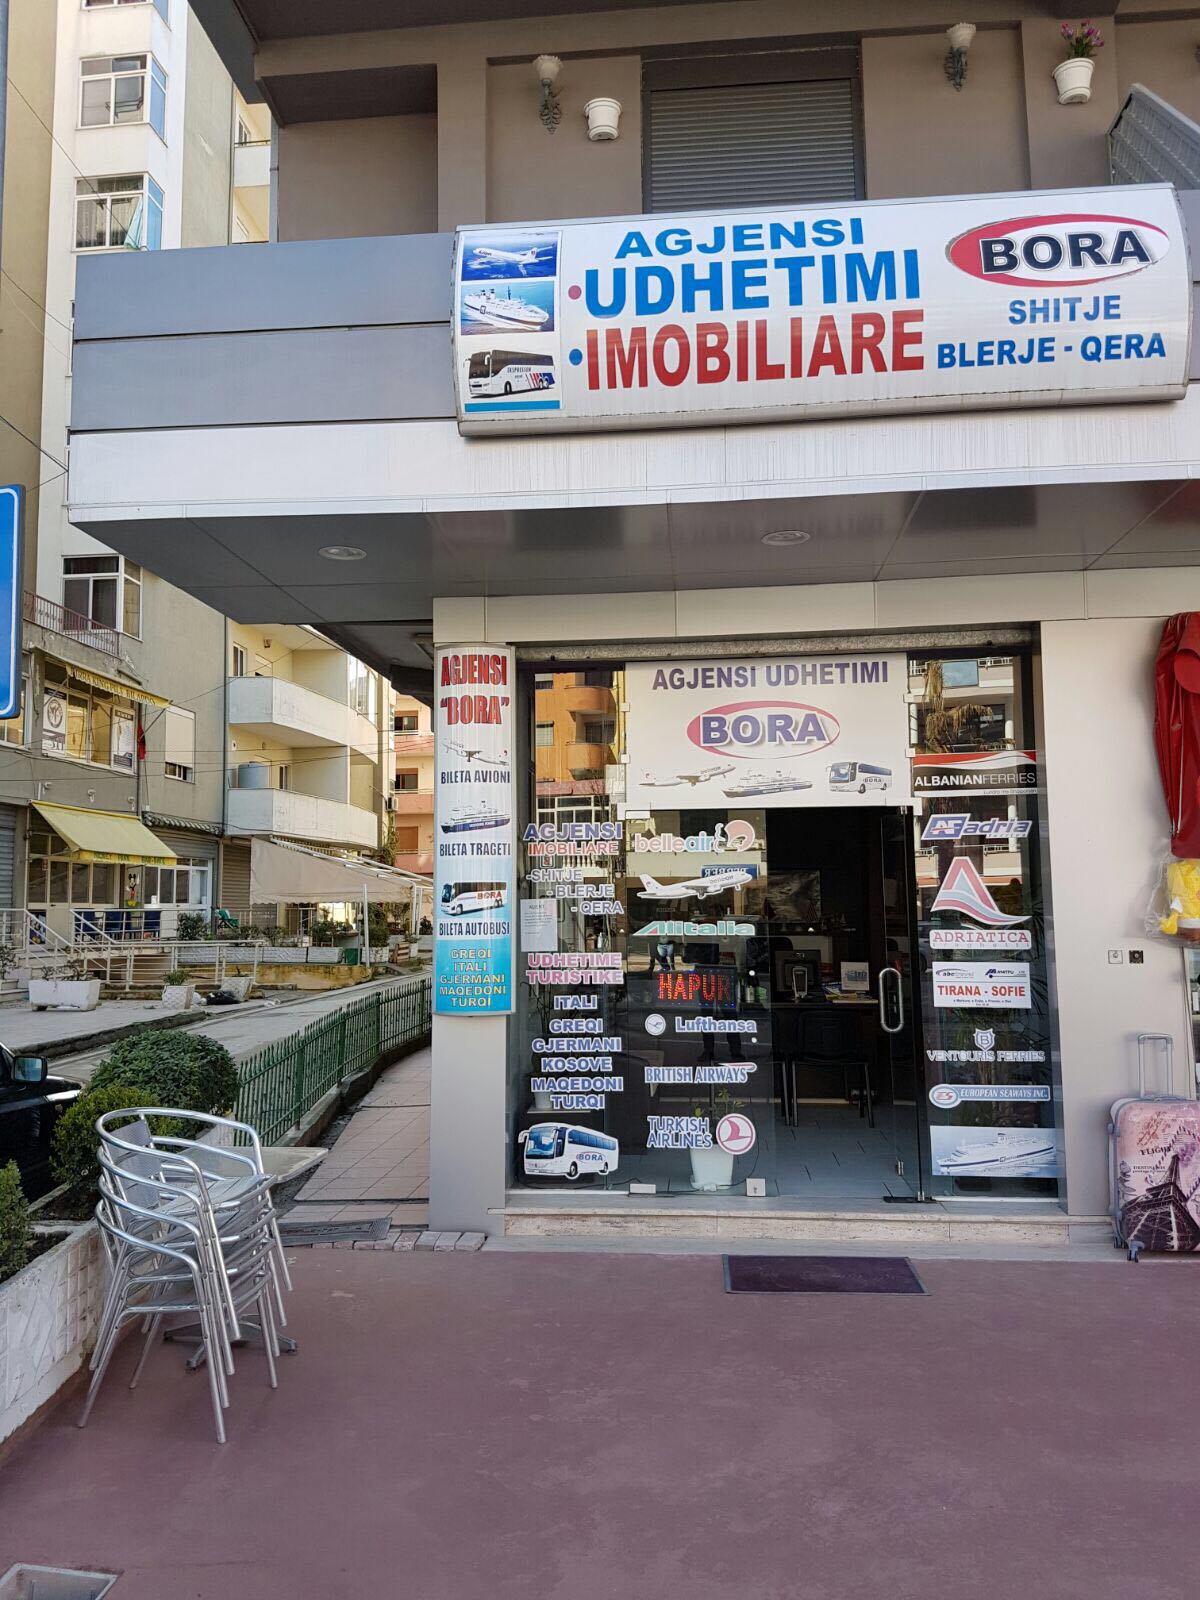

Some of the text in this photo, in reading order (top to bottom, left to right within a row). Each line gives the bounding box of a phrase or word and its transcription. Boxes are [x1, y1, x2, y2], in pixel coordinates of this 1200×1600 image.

[615, 218, 864, 259] AGJENSI
[980, 231, 1151, 274] BORA
[585, 249, 919, 316] UDHETIMI
[1009, 295, 1121, 324] SHITJE
[587, 310, 924, 390] IMOBILIARE
[937, 337, 1055, 369] BLERJE
[1081, 333, 1166, 363] QERA
[441, 654, 507, 686] AGJENSI
[652, 661, 888, 690] AGJENSI UDHETIMI
[702, 713, 826, 743] BORA
[441, 770, 510, 784] BILETA AVIONI
[914, 773, 1036, 786] ALBANIANFERRIES
[524, 823, 622, 840] AGJENSI
[963, 818, 1029, 833] adria
[528, 842, 618, 856] IMOBILIARE
[635, 831, 715, 852] belleair
[440, 843, 511, 856] BILETA TRAGETI
[477, 891, 502, 899] BORA
[556, 884, 614, 898] BLERJE
[581, 901, 624, 914] QERA
[439, 922, 462, 936] BILETA
[465, 921, 510, 936] AUTOBUSI
[633, 920, 755, 935] Alitalia
[933, 931, 1028, 943] ADRIATICA
[451, 949, 491, 959] GREQI
[528, 953, 622, 968] UDHETIME
[454, 962, 487, 972] ITALI
[440, 974, 505, 984] GJERMANI
[526, 970, 624, 984] TURISTIKE
[440, 986, 506, 996] MAQEDONI
[658, 973, 730, 1000] HAPUR
[937, 985, 981, 996] TIRANA
[992, 986, 1025, 996] SOFIE
[451, 997, 491, 1007] TURQI
[554, 995, 597, 1010] ITALI
[549, 1018, 603, 1033] GREQI
[675, 1017, 757, 1032] Lufthansa
[532, 1037, 622, 1053] GJERMANI
[927, 1050, 1045, 1062] VENTOURIS FERRIES
[542, 1057, 612, 1072] KOSOVE
[645, 1067, 747, 1083] BRITISH AIRWAYS
[531, 1077, 623, 1092] MAQEDONI
[961, 1088, 1047, 1098] EUROPEAN SEAWAYS INC.
[551, 1094, 605, 1109] TURQI
[648, 1117, 710, 1131] TURKISH
[647, 1132, 712, 1148] AIRLINES
[579, 1152, 603, 1161] BORA
